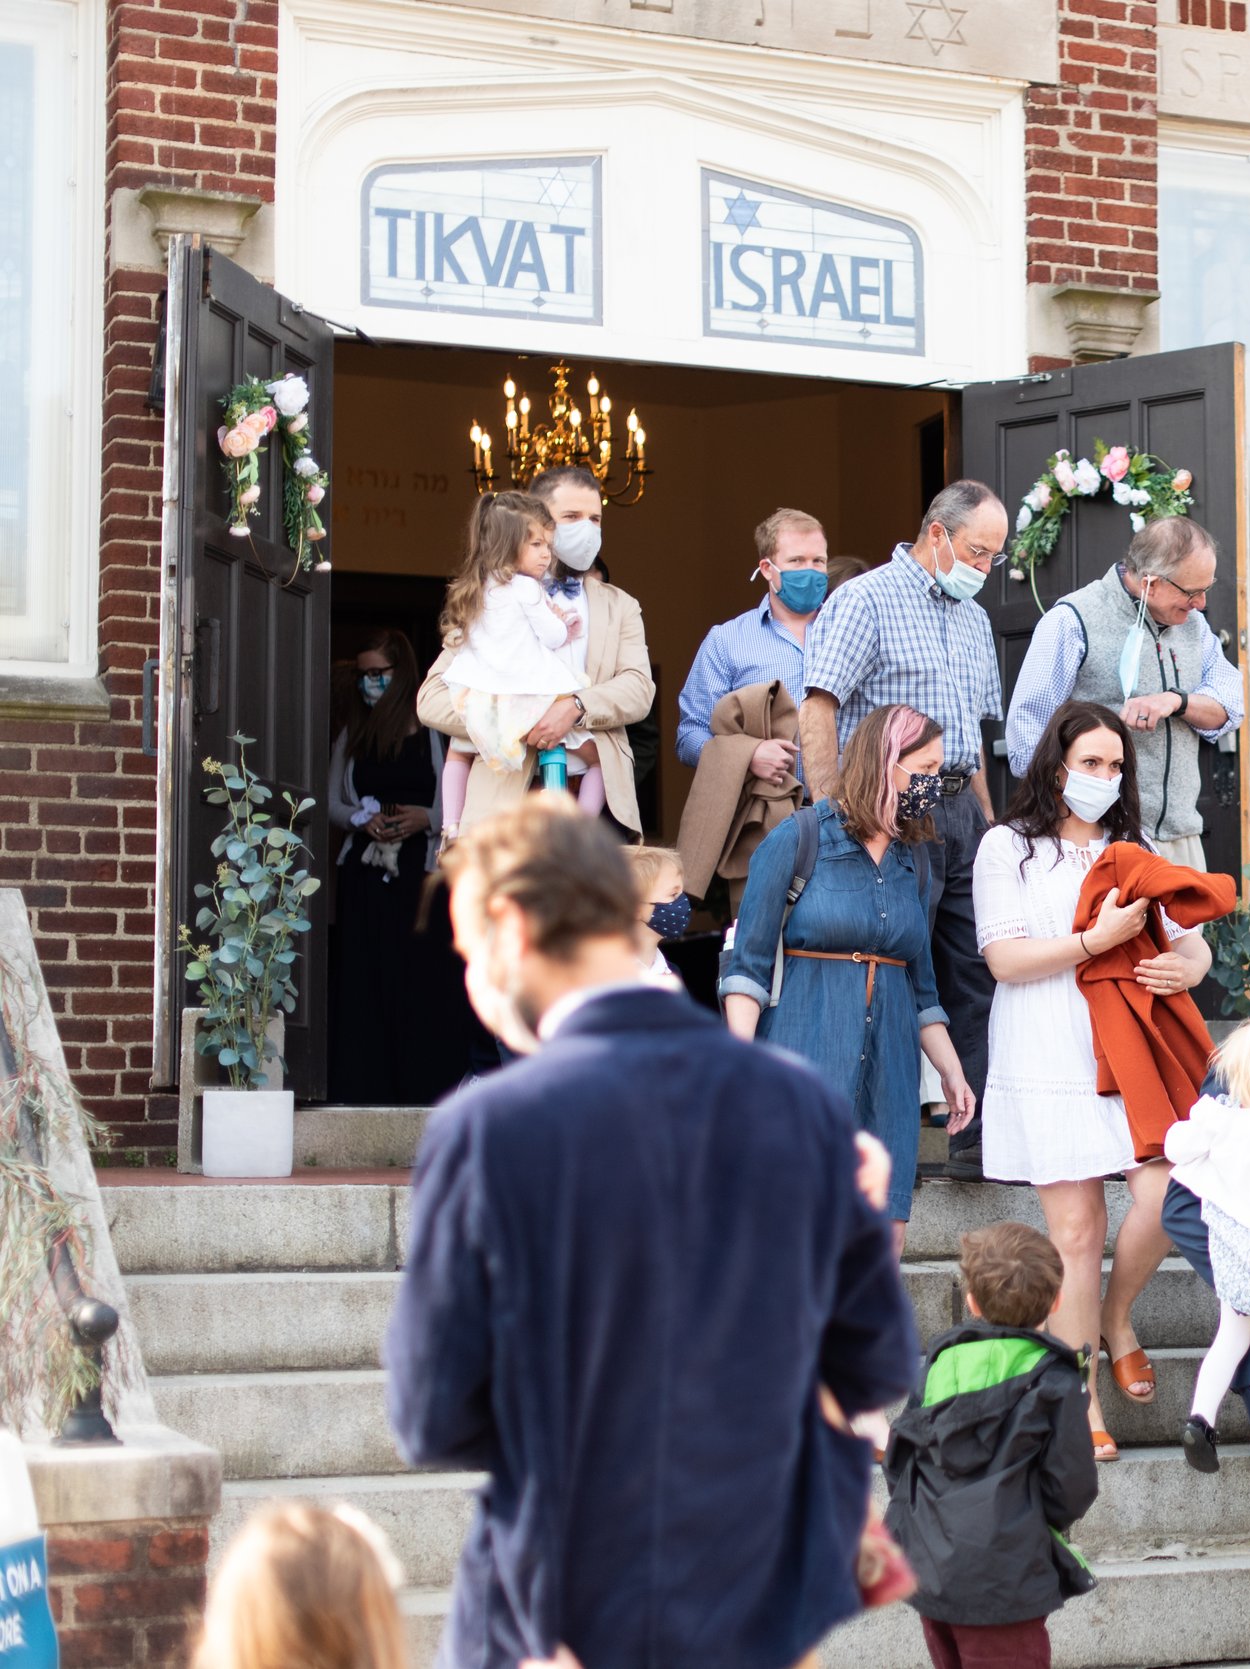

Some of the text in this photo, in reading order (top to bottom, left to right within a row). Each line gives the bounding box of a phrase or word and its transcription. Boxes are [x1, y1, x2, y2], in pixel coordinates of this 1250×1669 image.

[375, 207, 916, 326] TIKVAT ISRAEL
[412, 472, 448, 494] מה
[6, 1562, 29, 1597] ON
[30, 1557, 42, 1588] A
